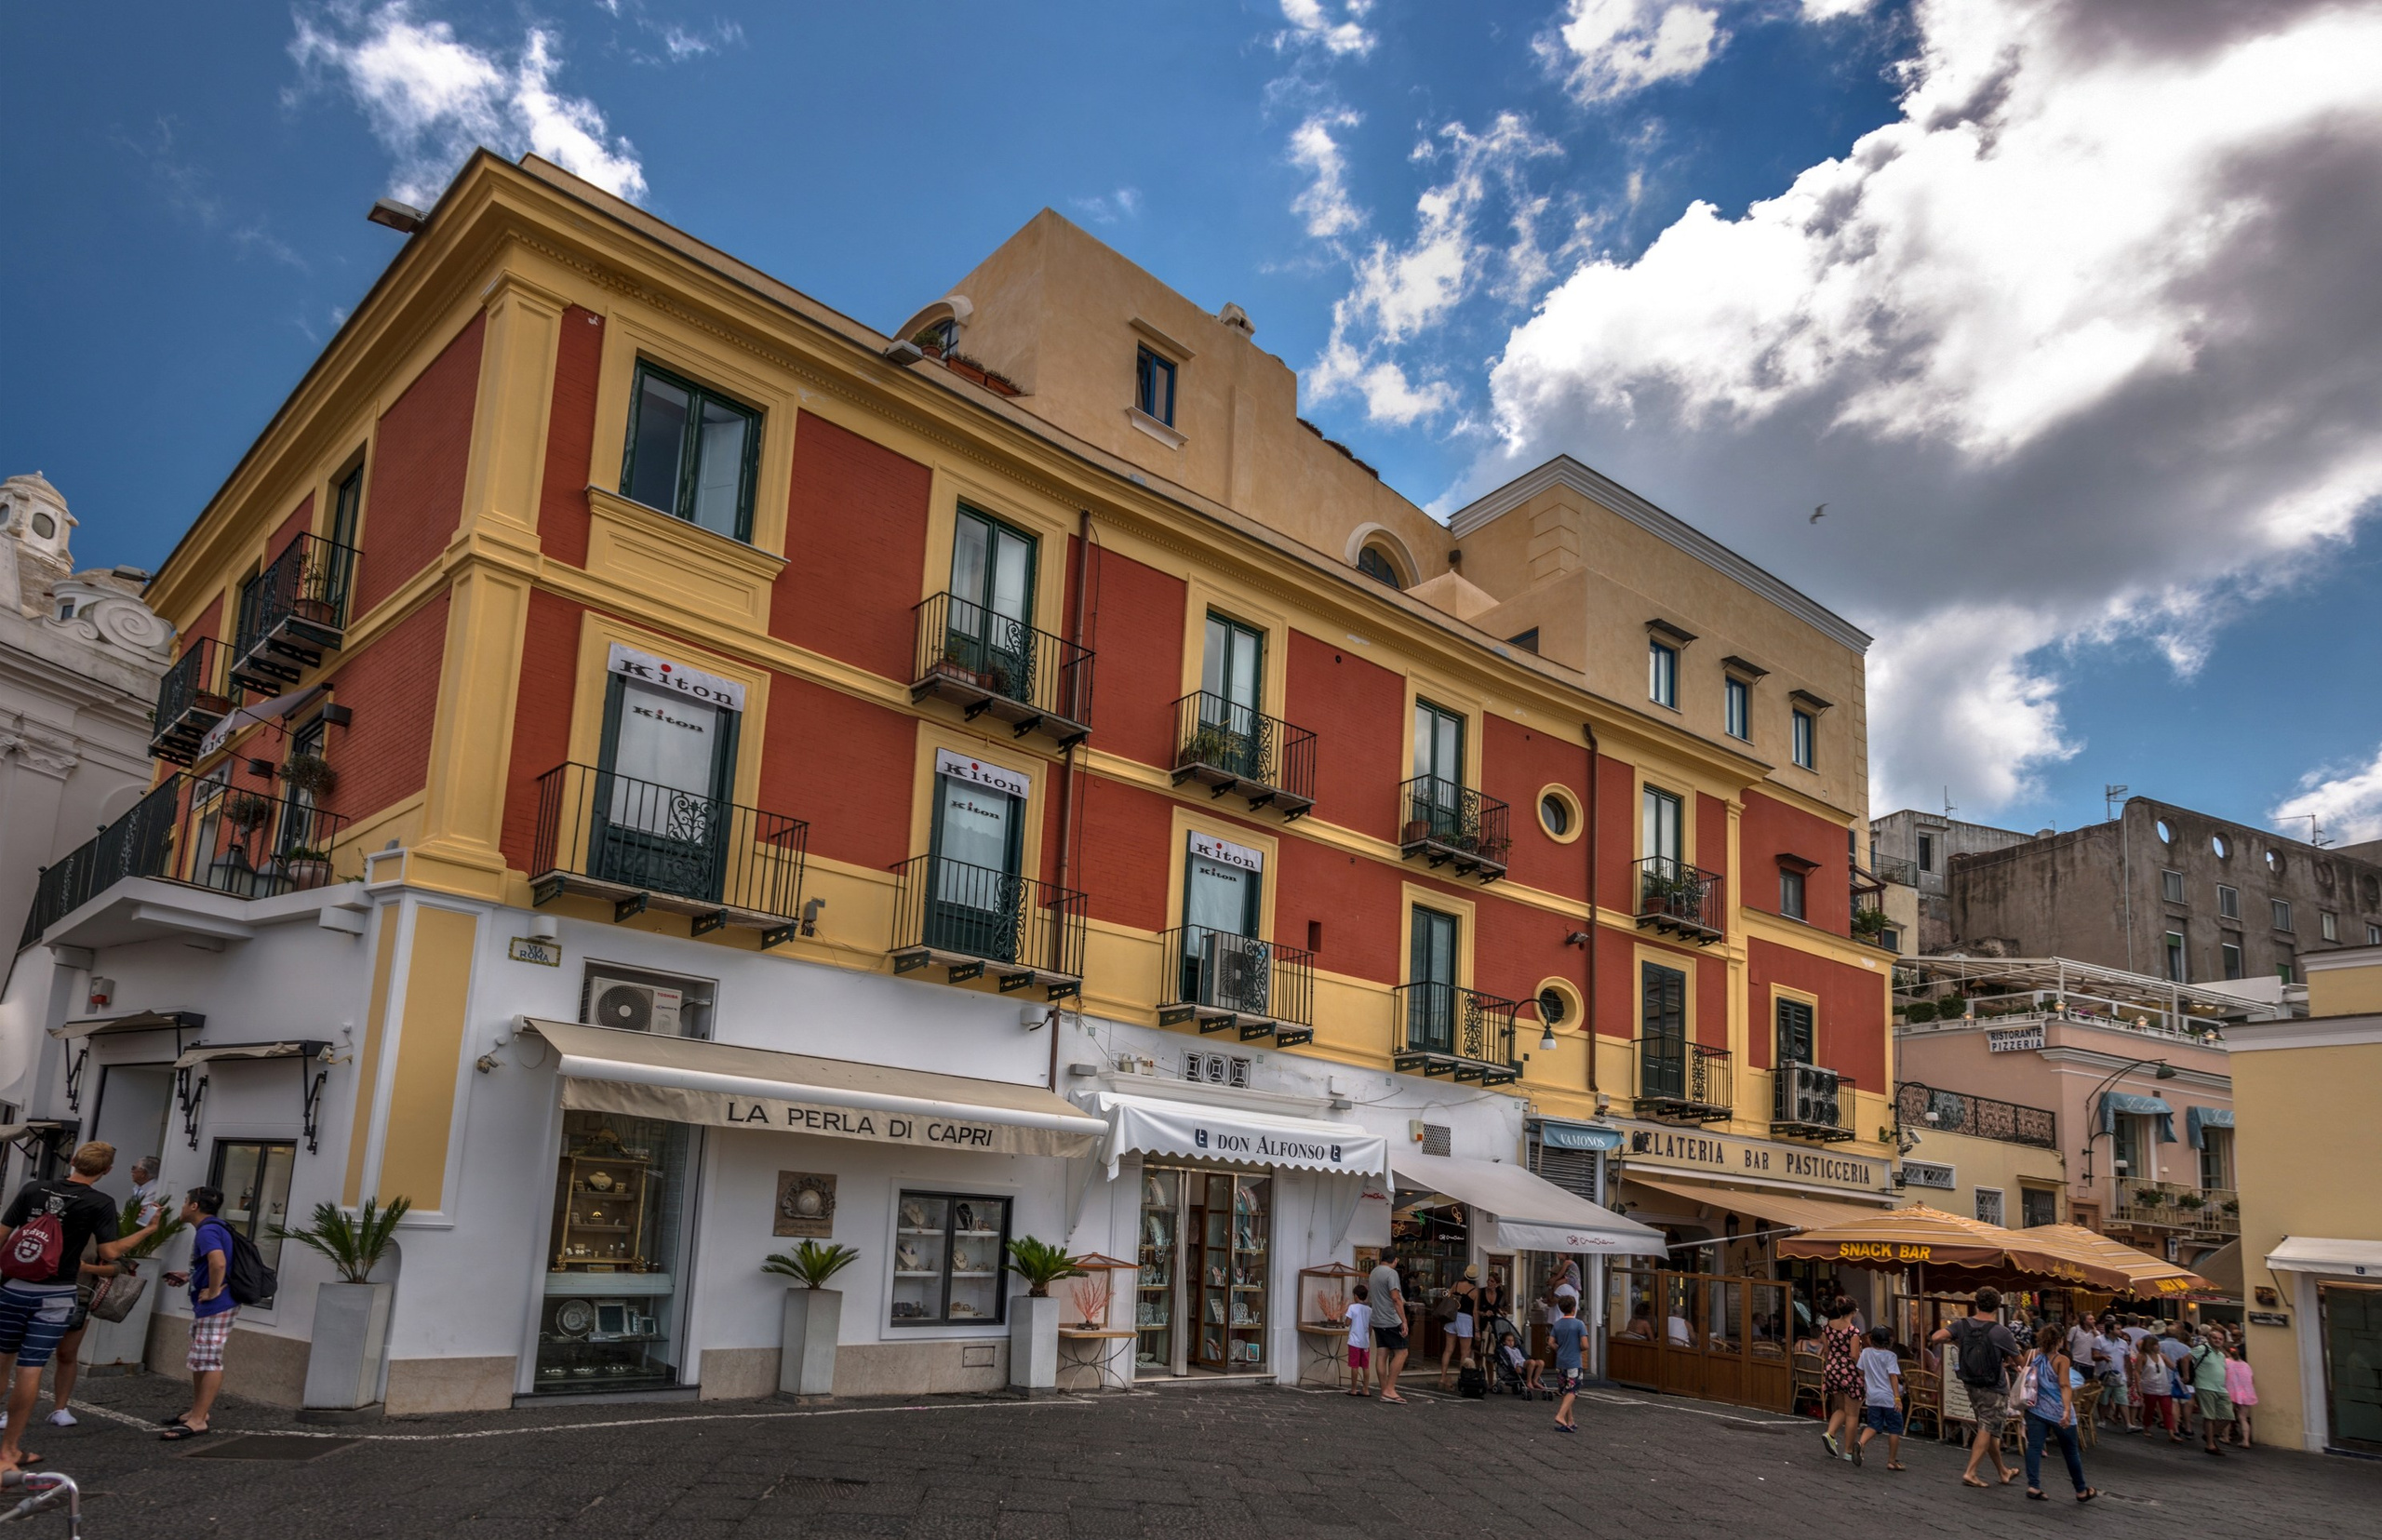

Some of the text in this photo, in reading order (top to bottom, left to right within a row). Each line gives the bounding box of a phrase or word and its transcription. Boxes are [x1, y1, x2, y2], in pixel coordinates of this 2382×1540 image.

[620, 659, 734, 706] Kiton
[632, 705, 704, 733] Kiton
[943, 761, 1023, 795] Kiton
[950, 800, 1000, 820] Kiton
[1196, 842, 1255, 869] Kiton
[1199, 866, 1238, 882] Kiton
[519, 950, 550, 963] ROMA
[528, 944, 544, 955] VIA
[1990, 1027, 2042, 1041] RISTORANTE
[1991, 1038, 2042, 1051] PIZZERIA
[728, 1102, 993, 1146] LA PERLA DI CAPRI
[1217, 1133, 1325, 1160] DON ALFONSO
[1560, 1133, 1606, 1148] VAMONOS
[1745, 1149, 1770, 1170] BAR
[1786, 1152, 1870, 1185] PASTICCERIA
[1840, 1242, 1932, 1259] SNACK BAR
